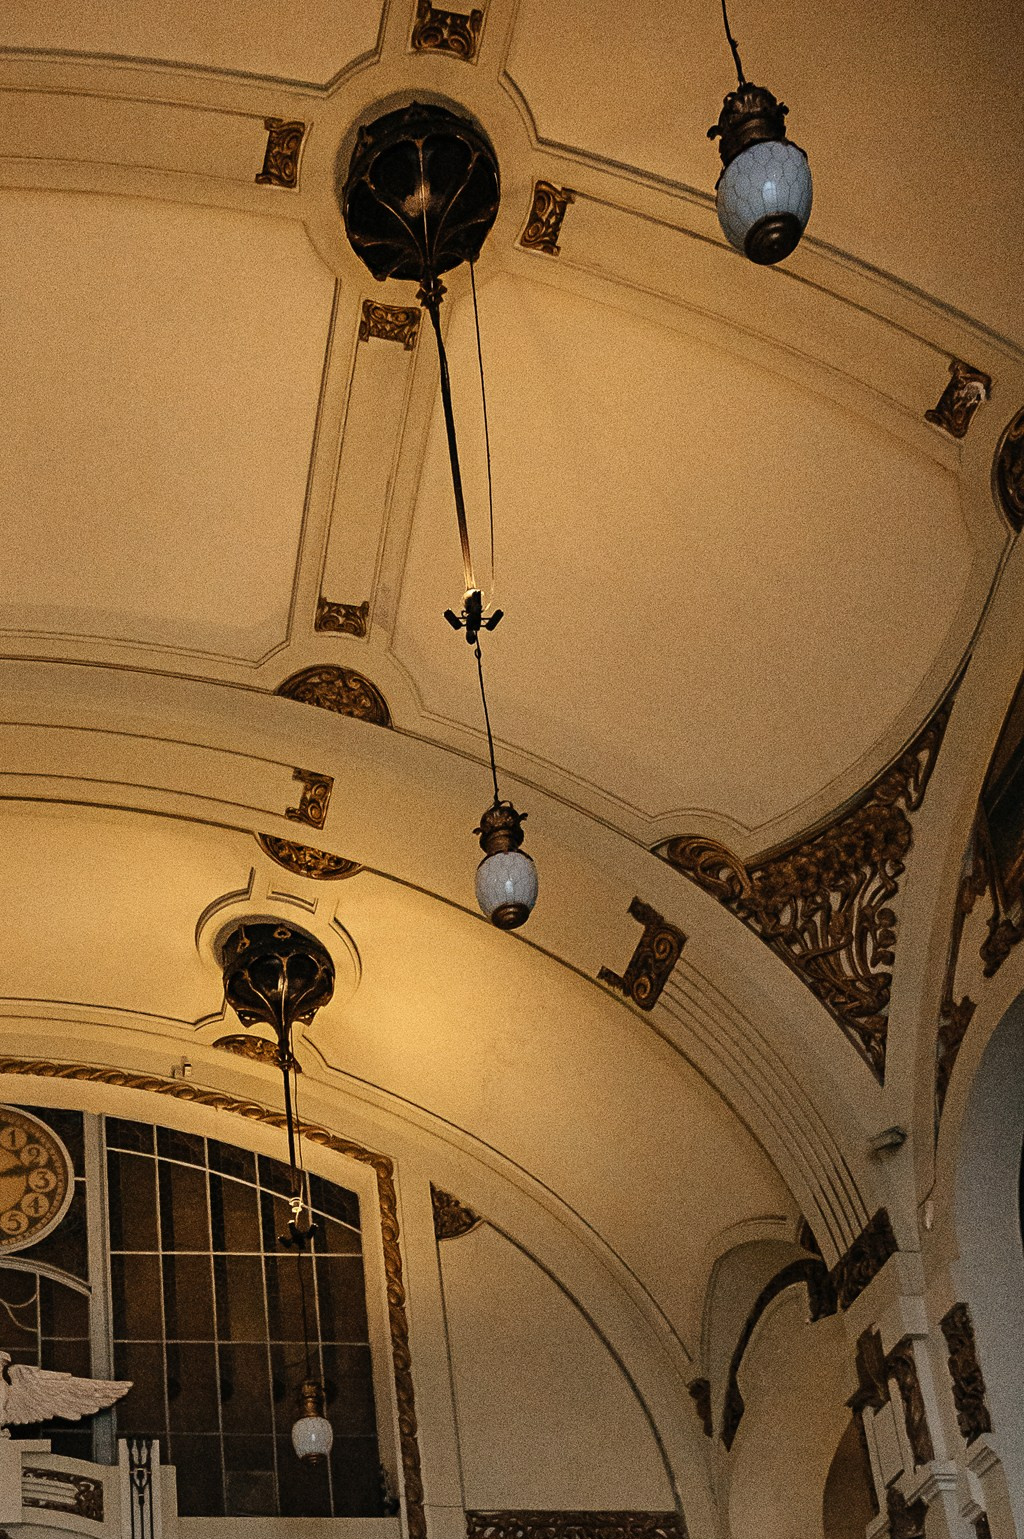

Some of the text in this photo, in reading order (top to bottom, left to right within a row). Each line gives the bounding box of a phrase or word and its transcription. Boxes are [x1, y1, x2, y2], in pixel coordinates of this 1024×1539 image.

[8, 1129, 18, 1146] 1
[34, 1171, 50, 1190] 3
[28, 1195, 43, 1213] 4
[6, 1214, 21, 1231] 5
